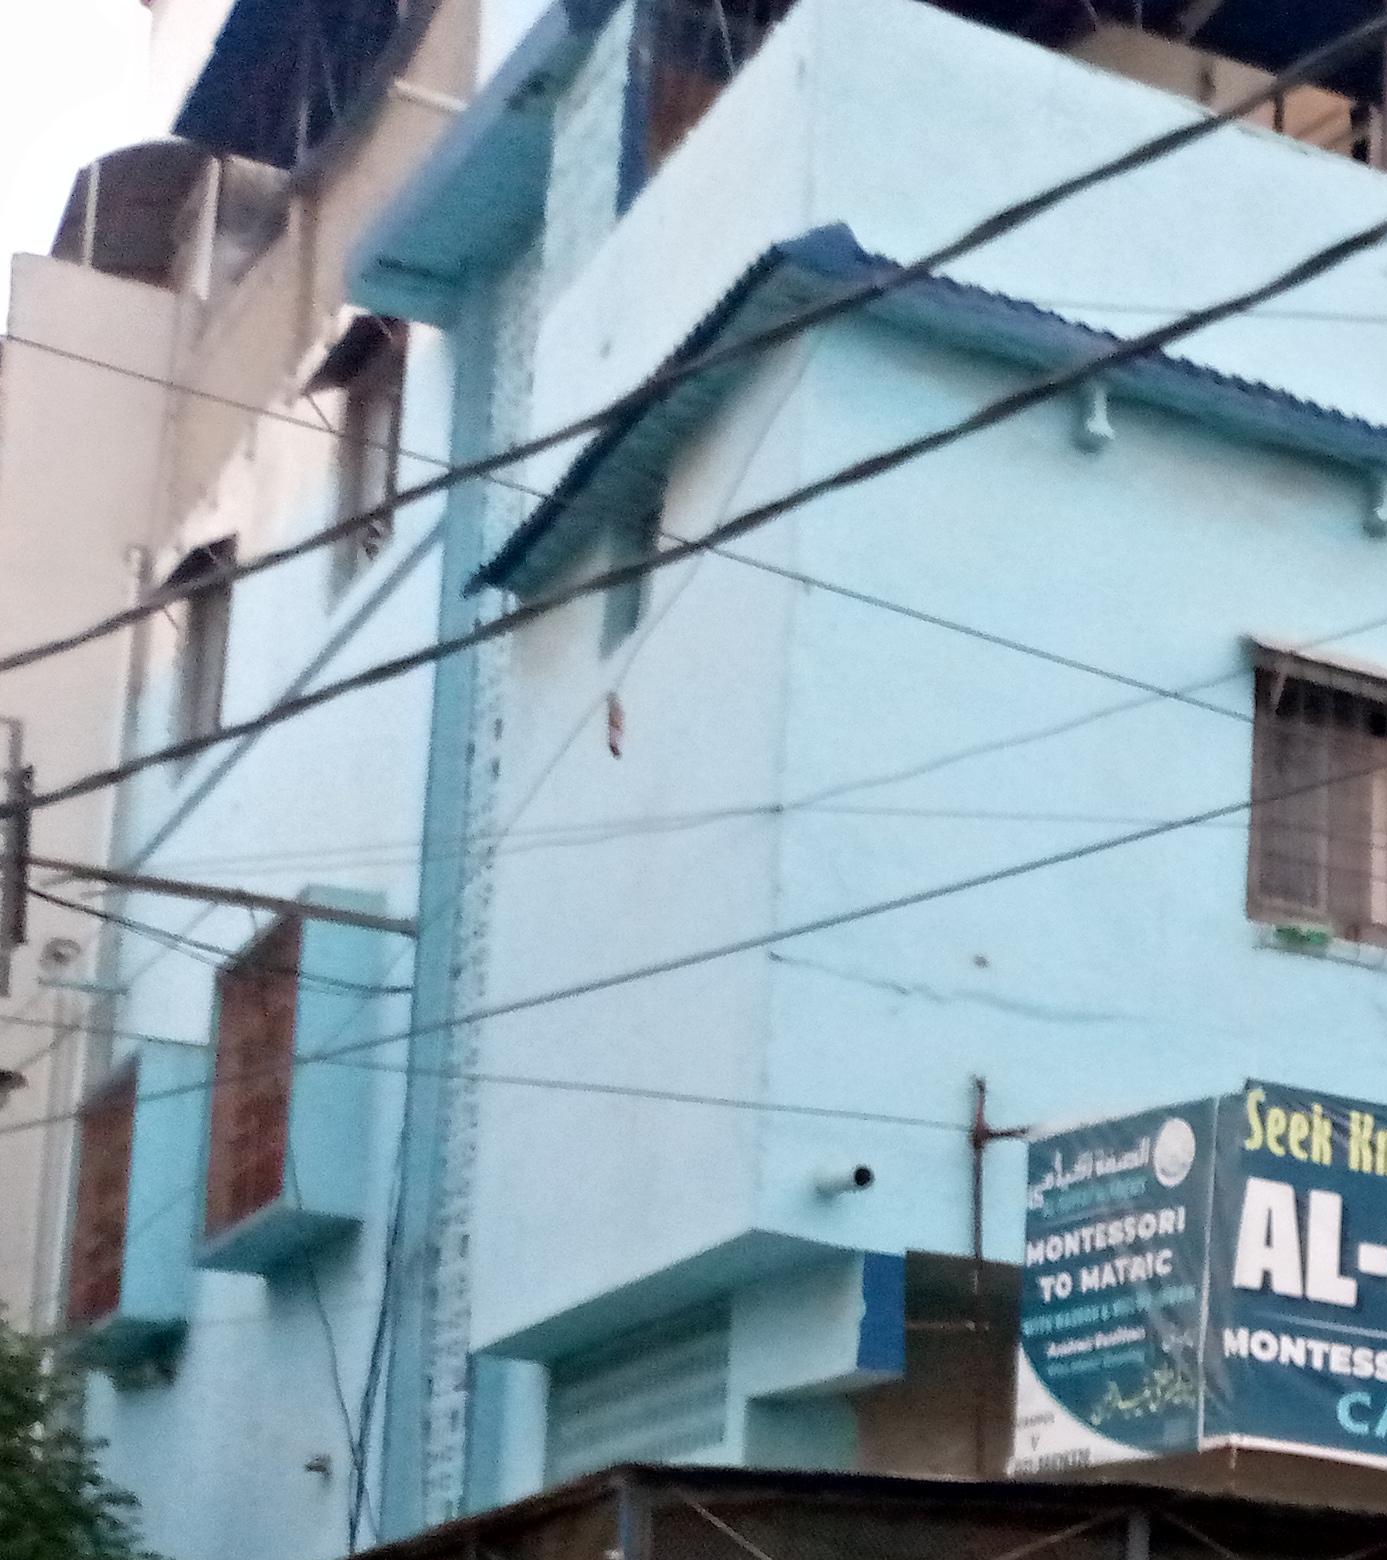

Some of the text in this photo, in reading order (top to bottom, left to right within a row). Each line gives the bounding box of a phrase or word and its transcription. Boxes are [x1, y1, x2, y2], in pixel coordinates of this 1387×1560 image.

[1244, 1088, 1332, 1166] Seek
[1026, 1205, 1186, 1268] MONTESSORI
[1039, 1248, 1173, 1302] TO MATRIC
